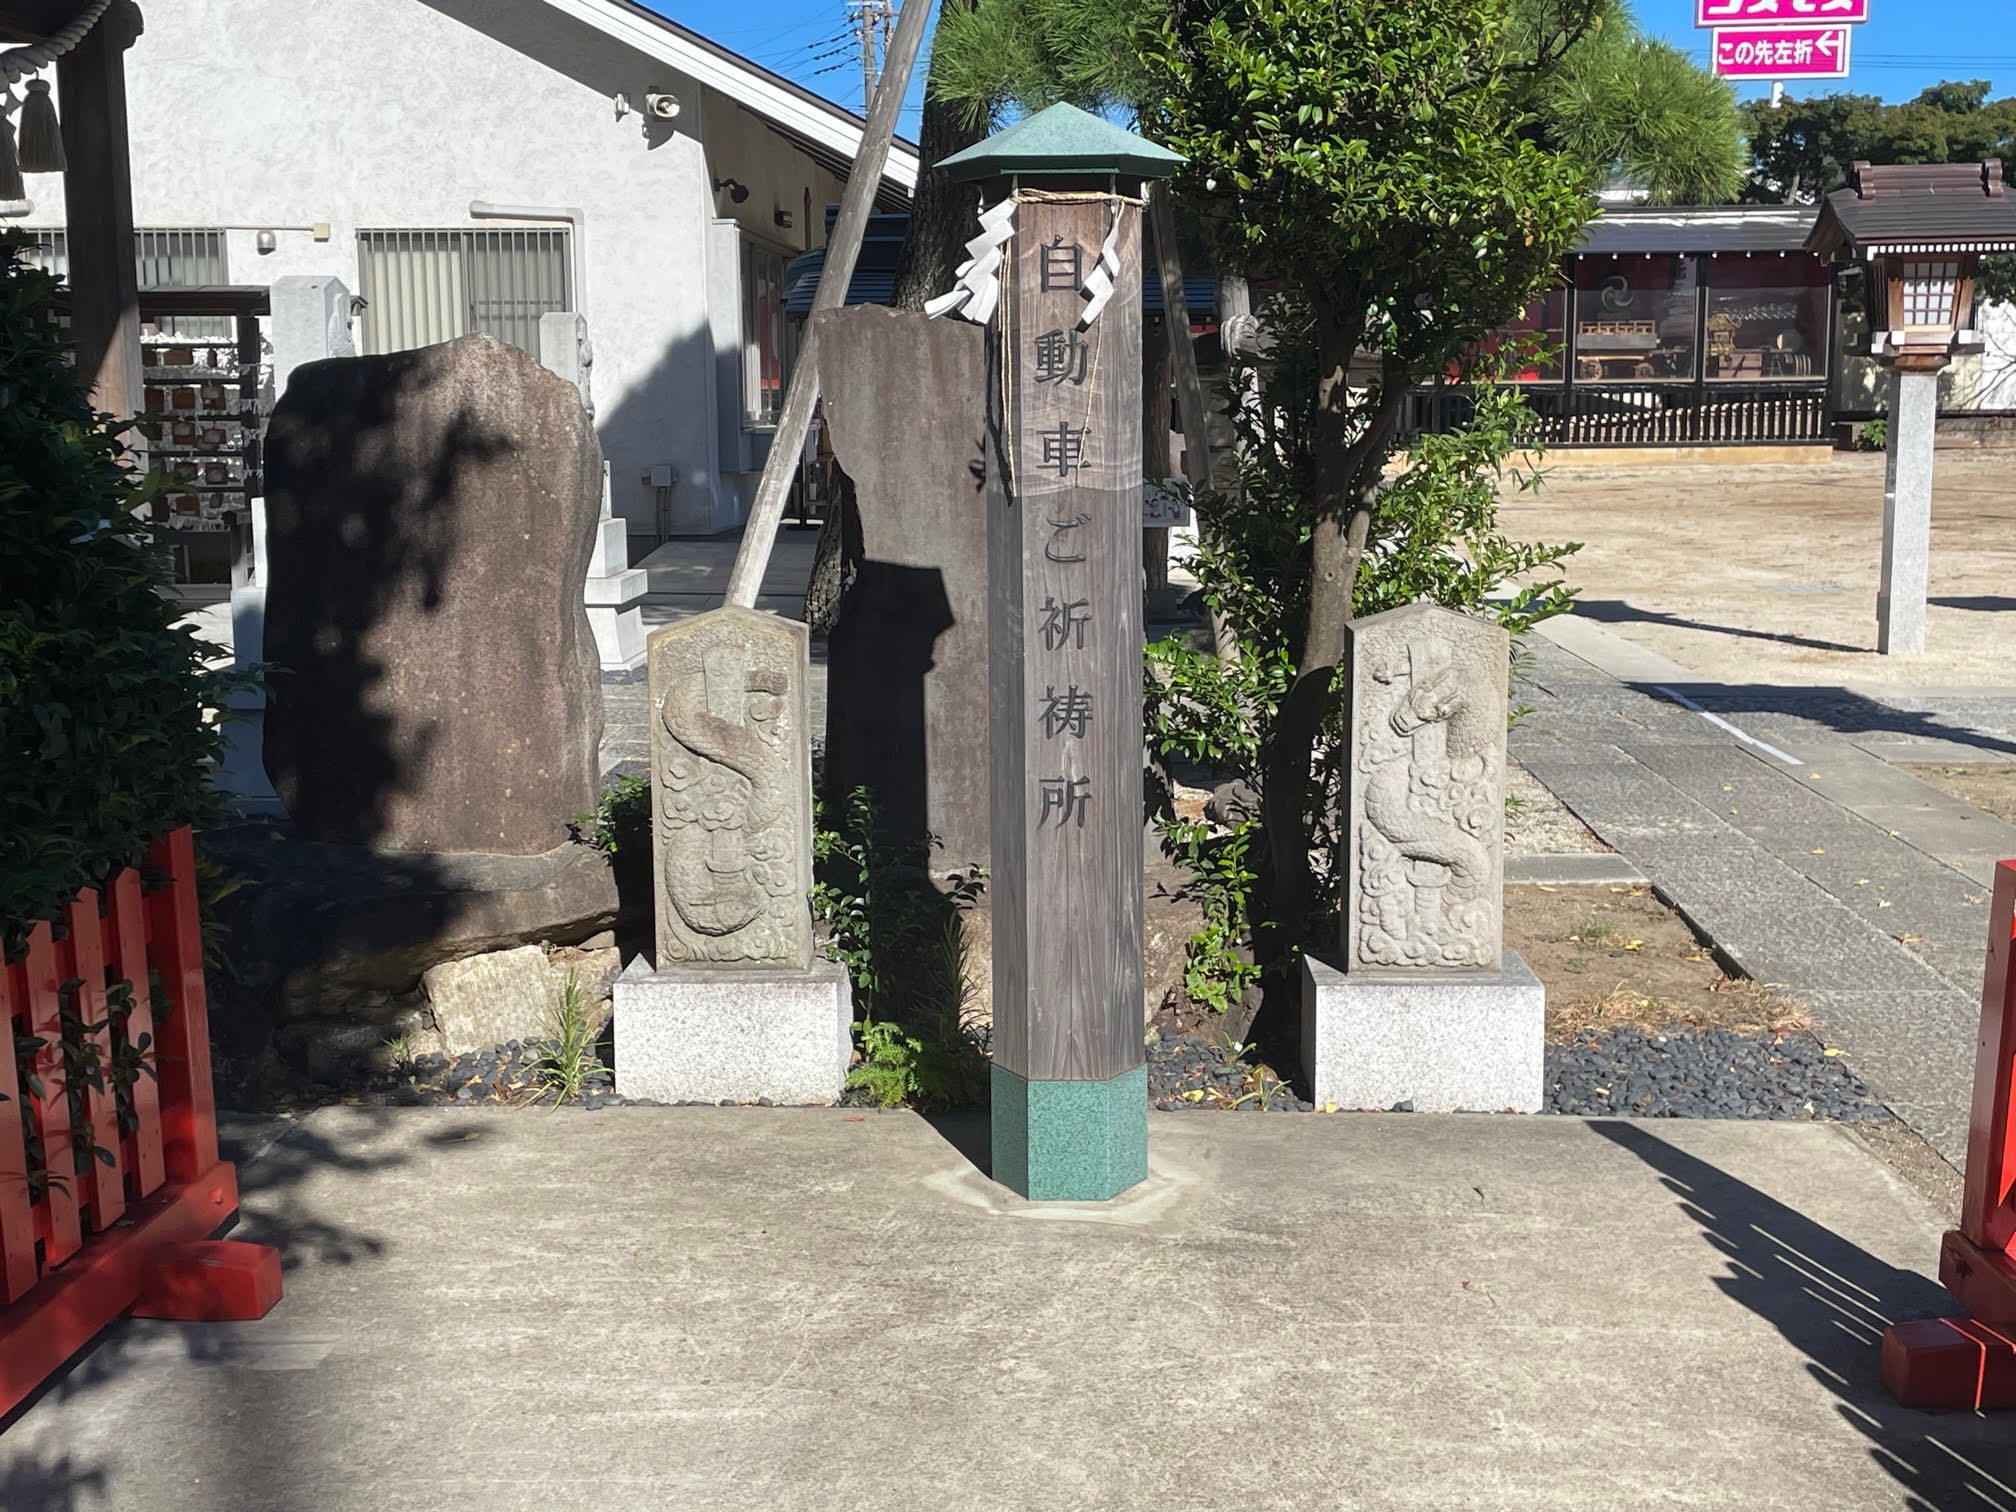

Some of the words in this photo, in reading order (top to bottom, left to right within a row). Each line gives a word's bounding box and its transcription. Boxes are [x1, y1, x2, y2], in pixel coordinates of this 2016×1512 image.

[1718, 39, 1813, 65] この先左折
[1034, 234, 1092, 829] 自動車ご祈祷所
